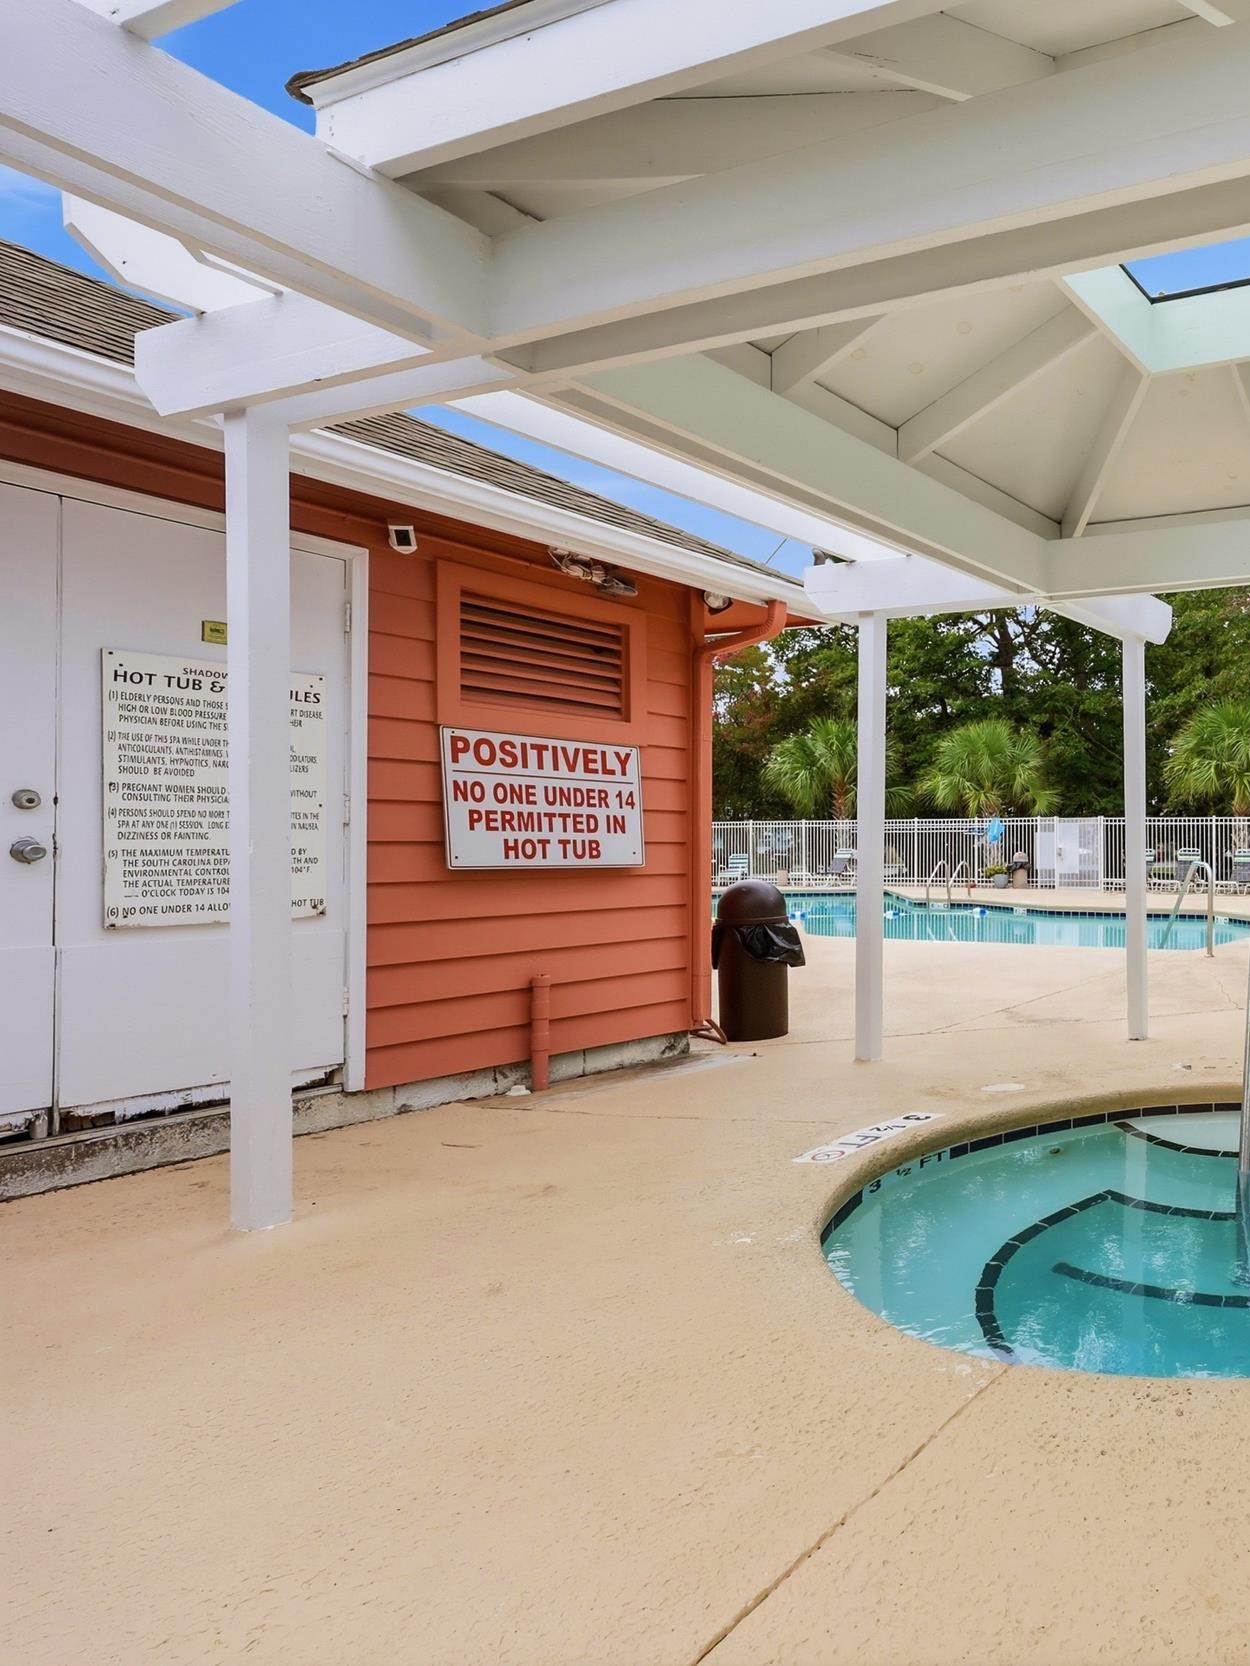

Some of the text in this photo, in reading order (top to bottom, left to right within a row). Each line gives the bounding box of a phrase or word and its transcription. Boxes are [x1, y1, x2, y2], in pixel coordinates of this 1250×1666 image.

[113, 669, 157, 686] HOT
[164, 675, 202, 691] TUB
[210, 681, 225, 693] &
[108, 689, 118, 701] (1)
[120, 691, 152, 703] ELDERLY
[153, 695, 184, 706] PERSONS
[186, 698, 200, 708] AND
[202, 699, 223, 710] THOSE
[118, 703, 137, 713] HIGH
[140, 705, 149, 714] OR
[151, 706, 167, 716] LOW
[170, 708, 193, 718] BLOOD
[195, 710, 227, 721] PRESSURE
[119, 714, 157, 725] PHYSICIAN
[160, 718, 184, 728] BEFORE
[186, 720, 207, 730] USING
[209, 722, 221, 731] THE
[118, 732, 129, 741] THE
[131, 733, 143, 742] USE
[144, 734, 153, 742] OF
[154, 734, 168, 744] THIS
[169, 736, 180, 744] SPA
[182, 736, 200, 746] WHILE
[202, 738, 221, 747] UNDER
[118, 754, 168, 766] STIMULANTS,
[450, 735, 632, 777] POSITIVELY
[118, 765, 195, 777] SHOULD BE AVOIDED
[121, 783, 162, 793] PREGNANT
[165, 784, 195, 794] WOMEN
[197, 786, 226, 795] SHOULD
[452, 780, 636, 810] NO ONE UNDER 14
[121, 792, 229, 803] CONSULTING THEIR PHYSICIA
[108, 808, 117, 819] (4)
[118, 808, 147, 818] PERSONS
[149, 809, 175, 818] SHOULD
[177, 809, 196, 818] SPEND
[198, 810, 207, 818] NO
[208, 810, 224, 819] MORE
[303, 812, 308, 820] IN
[310, 812, 319, 820] THE
[117, 820, 130, 829] SPA
[131, 820, 140, 829] AT
[142, 820, 155, 829] ANY
[156, 821, 168, 829] ONE
[208, 821, 223, 829] LONG
[468, 809, 627, 834] PERMITTED IN
[117, 831, 210, 840] DIZZINESS OR FAINTING.
[108, 849, 118, 859] (5)
[121, 849, 137, 857] THE
[140, 849, 183, 857] MAXIMUM
[186, 848, 230, 857] TEMPERAT
[503, 838, 602, 860] HOT TUB
[123, 859, 139, 868] THE
[141, 859, 170, 867] SOUTH
[172, 858, 211, 867] CAROLINA
[304, 857, 318, 865] AND
[122, 868, 193, 878] ENVIRONMENTAL
[123, 880, 139, 888] THE
[142, 879, 173, 888] ACTUAL
[141, 889, 176, 898] O'CLOCK
[179, 888, 205, 896] TODAY
[106, 898, 324, 919] (6) NO ONE UNDER 14 ALLO HOT TUB
[838, 1134, 882, 1149] FT
[869, 1179, 882, 1194] 3
[919, 1150, 947, 1169] FT
